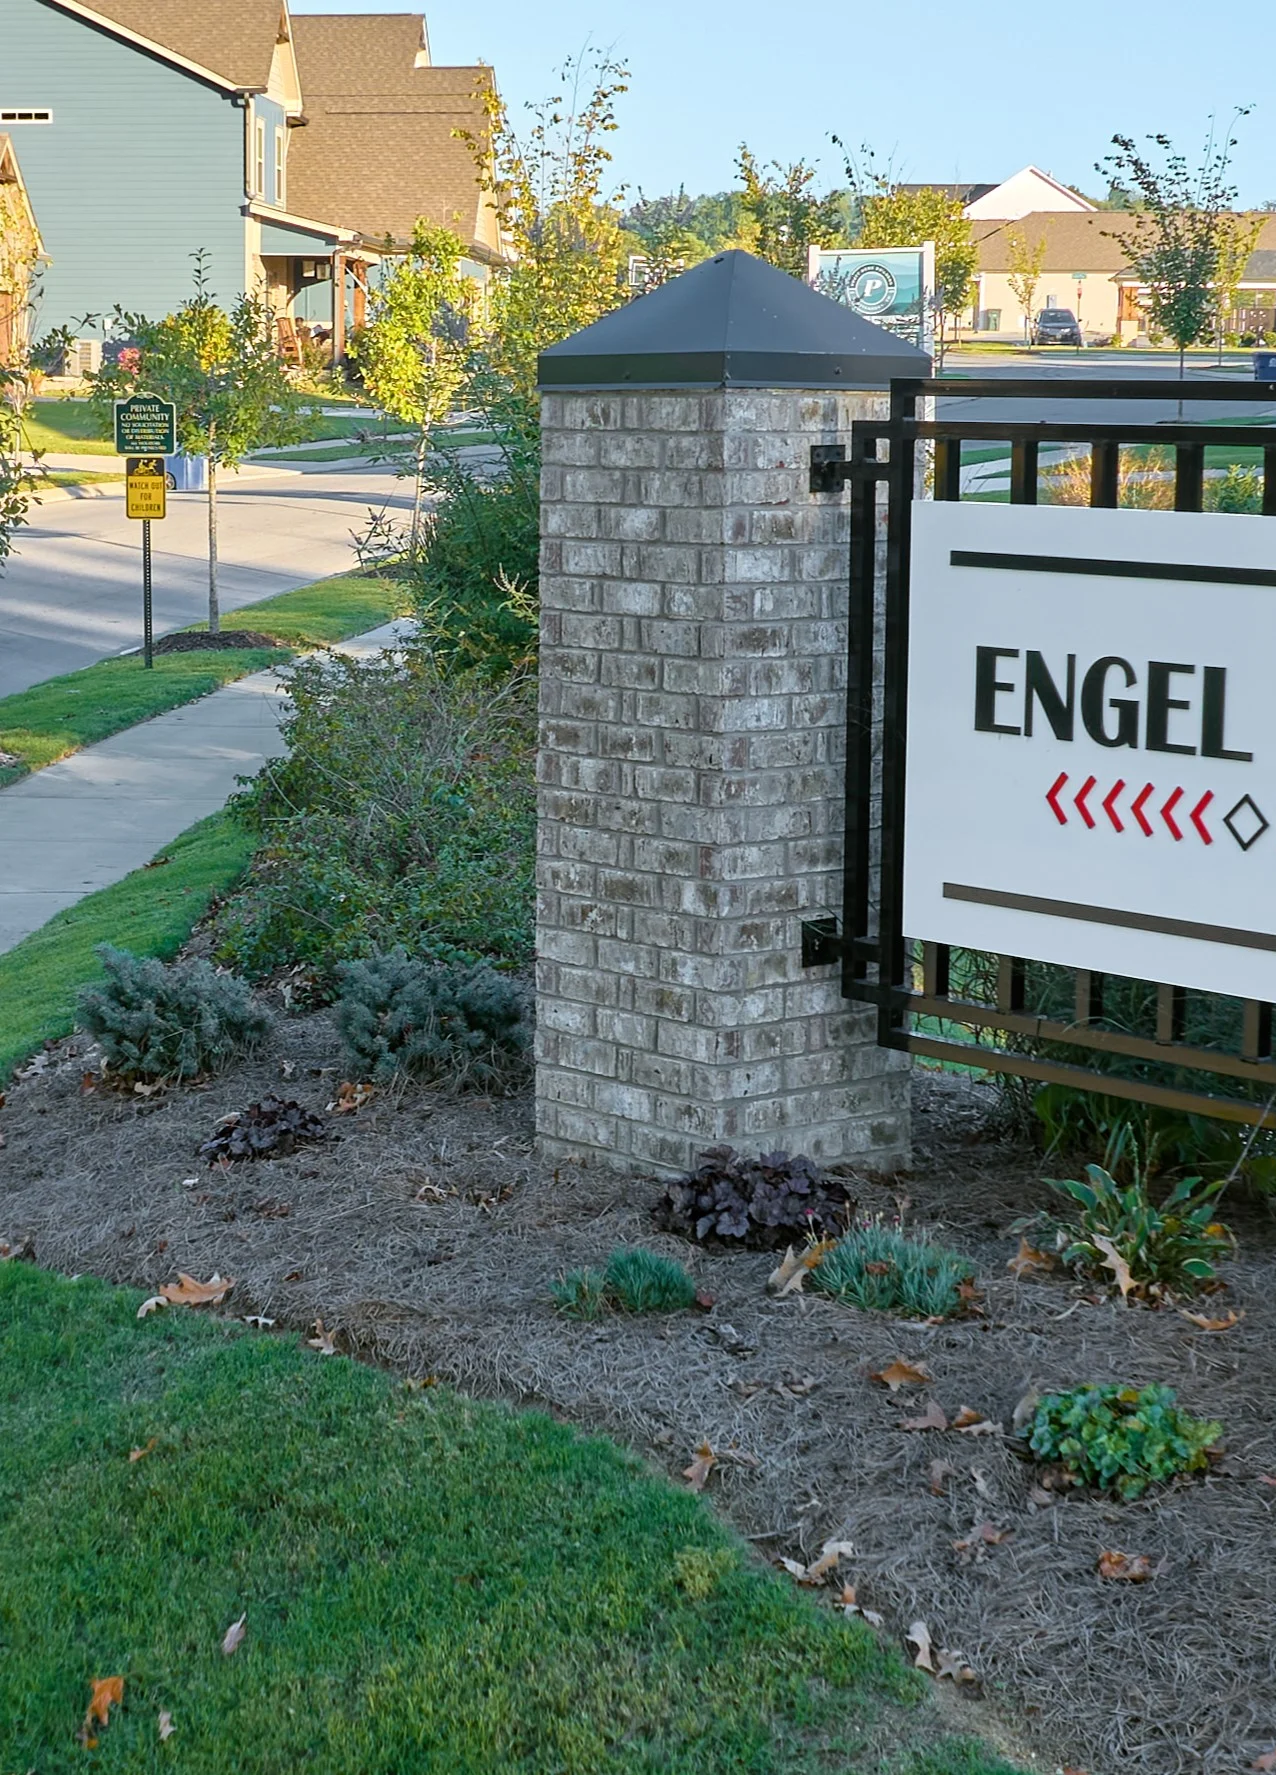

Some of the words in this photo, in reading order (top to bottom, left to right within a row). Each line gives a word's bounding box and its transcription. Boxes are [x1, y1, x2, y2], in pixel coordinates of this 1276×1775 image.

[863, 279, 883, 297] P
[130, 404, 160, 412] PRIVATE
[120, 413, 170, 421] COMMUNITY
[129, 482, 149, 490] WATCH
[150, 482, 163, 490] OUT
[140, 492, 152, 501] FOR
[131, 503, 161, 512] CHILDREN
[974, 645, 1253, 763] ENGEL
